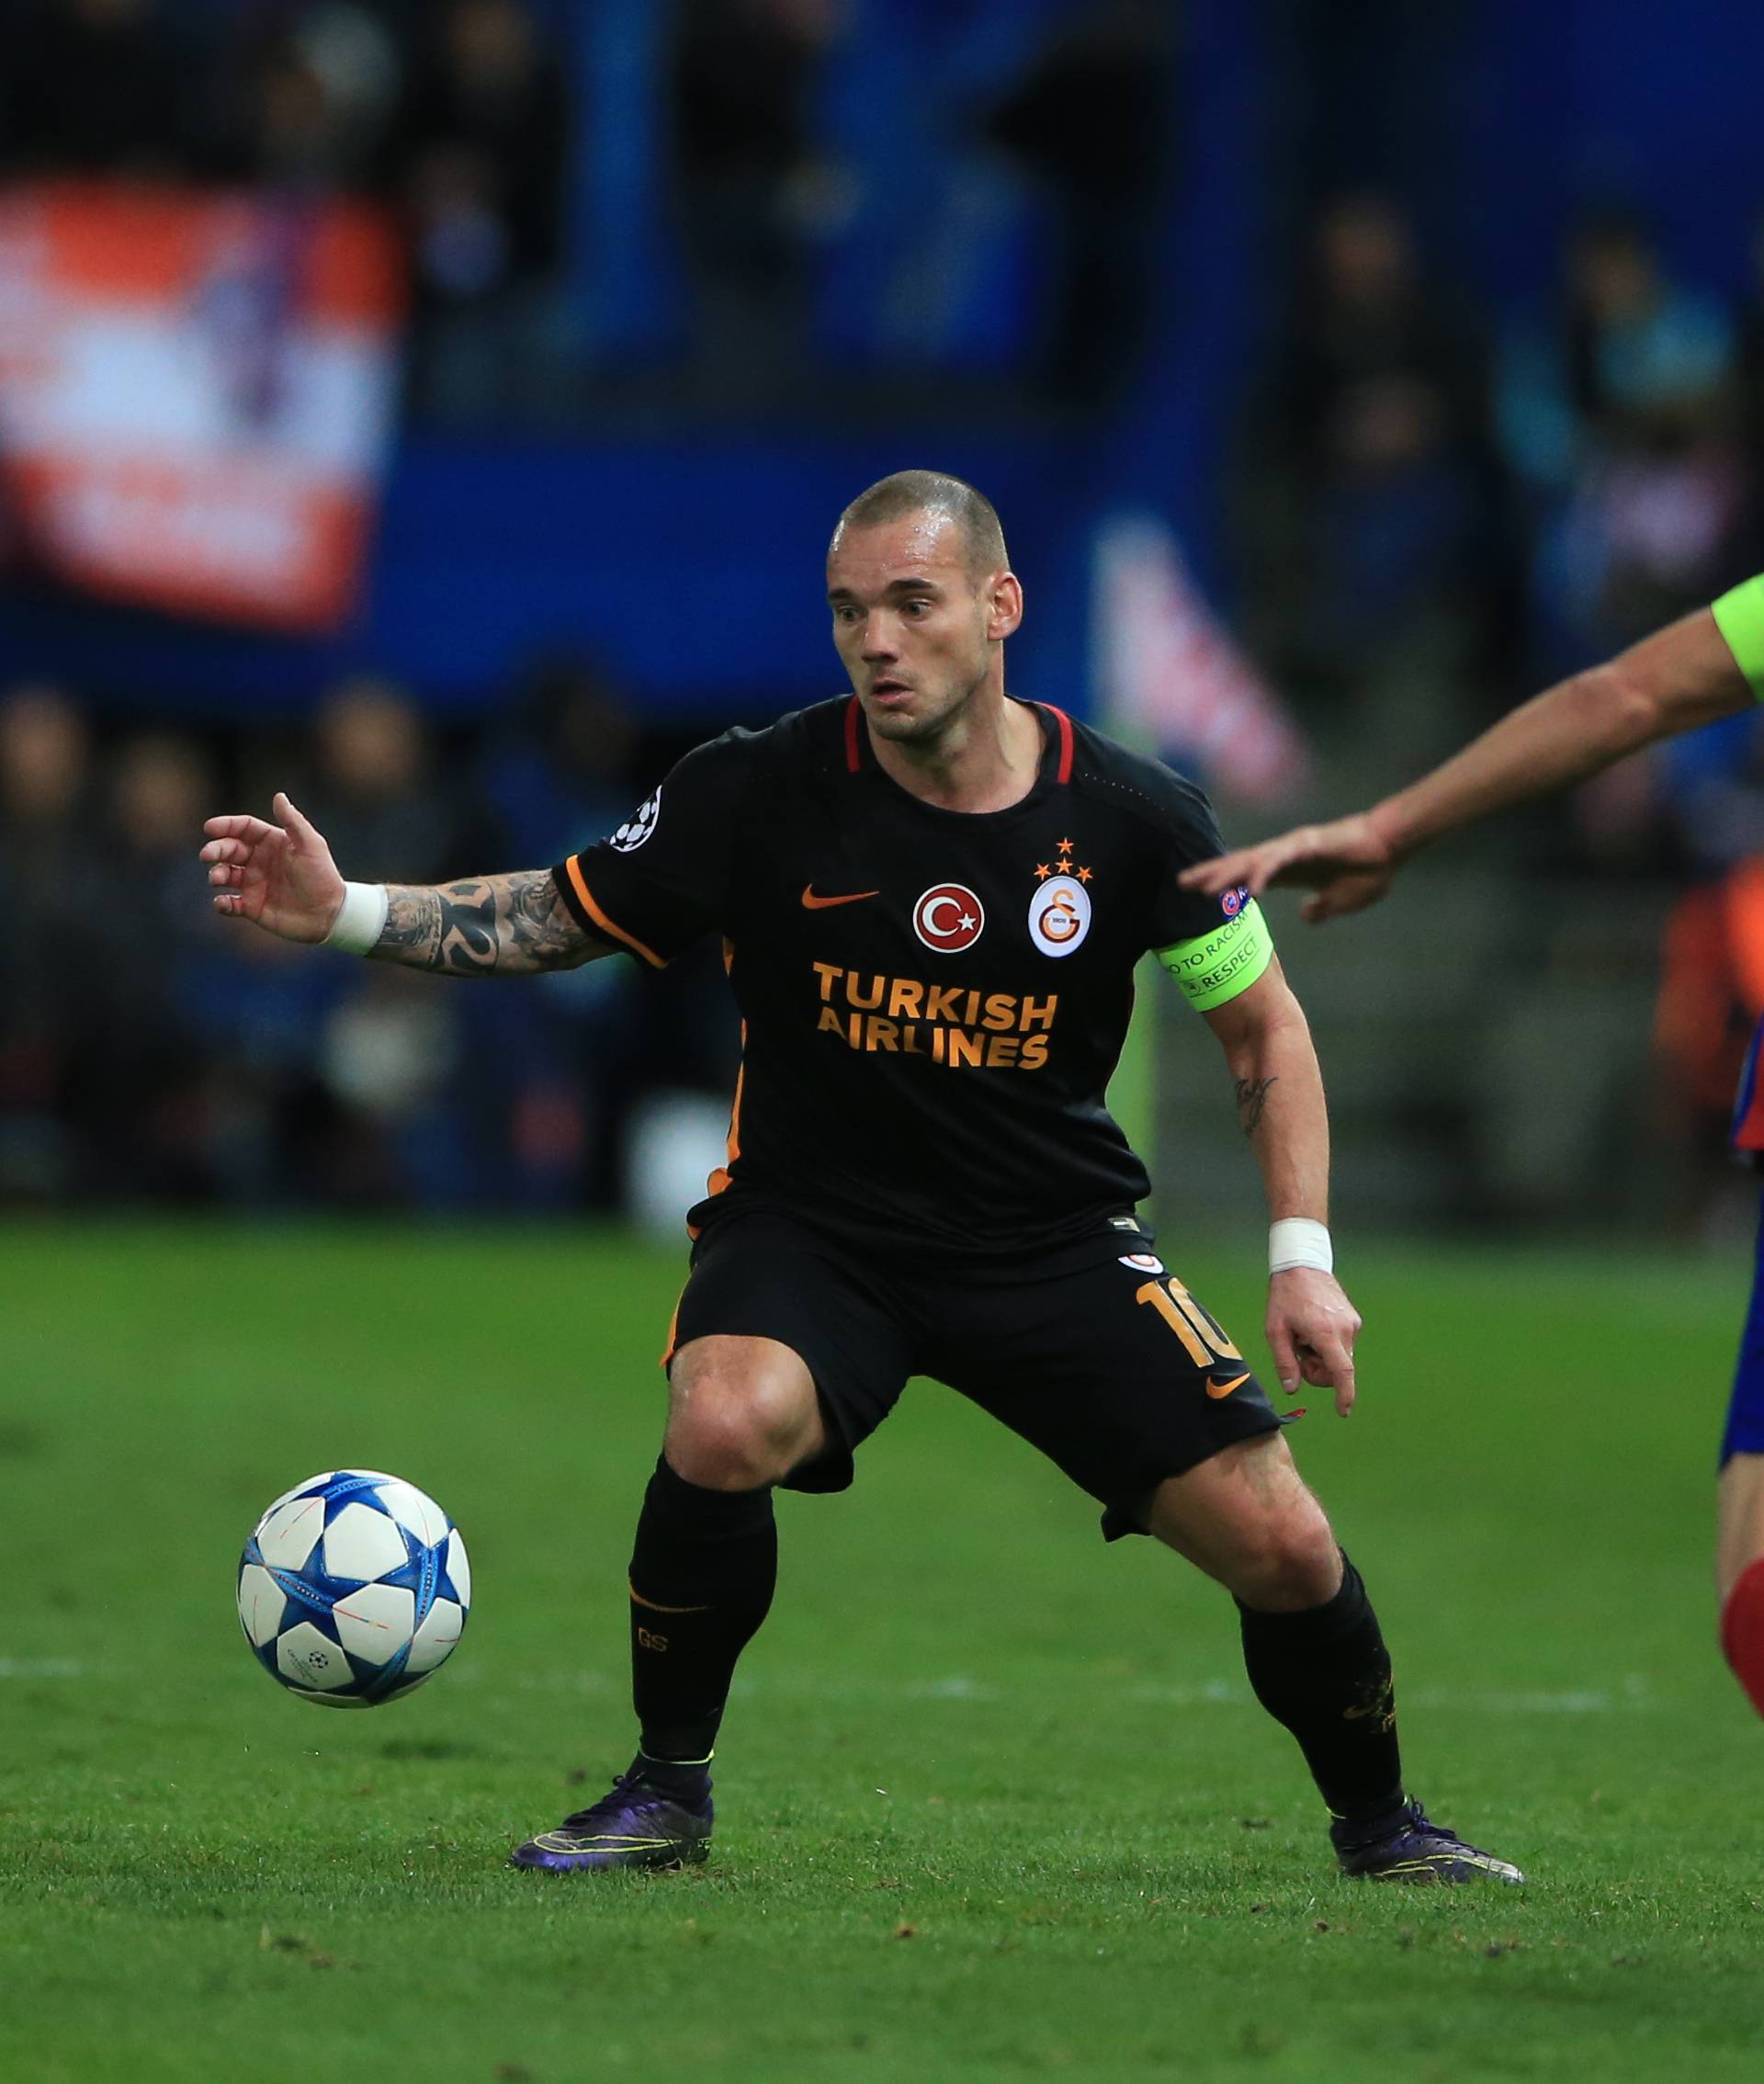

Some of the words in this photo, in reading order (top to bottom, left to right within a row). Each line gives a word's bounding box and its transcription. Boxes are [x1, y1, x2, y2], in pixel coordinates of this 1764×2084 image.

[1169, 964, 1182, 975] O
[1181, 953, 1204, 970] TO
[1205, 910, 1250, 957] RACISM
[1202, 935, 1258, 988] RESPECT
[812, 960, 1059, 1032] TURKISH
[817, 1006, 1050, 1070] AIRLINES
[1136, 1277, 1244, 1368] 10
